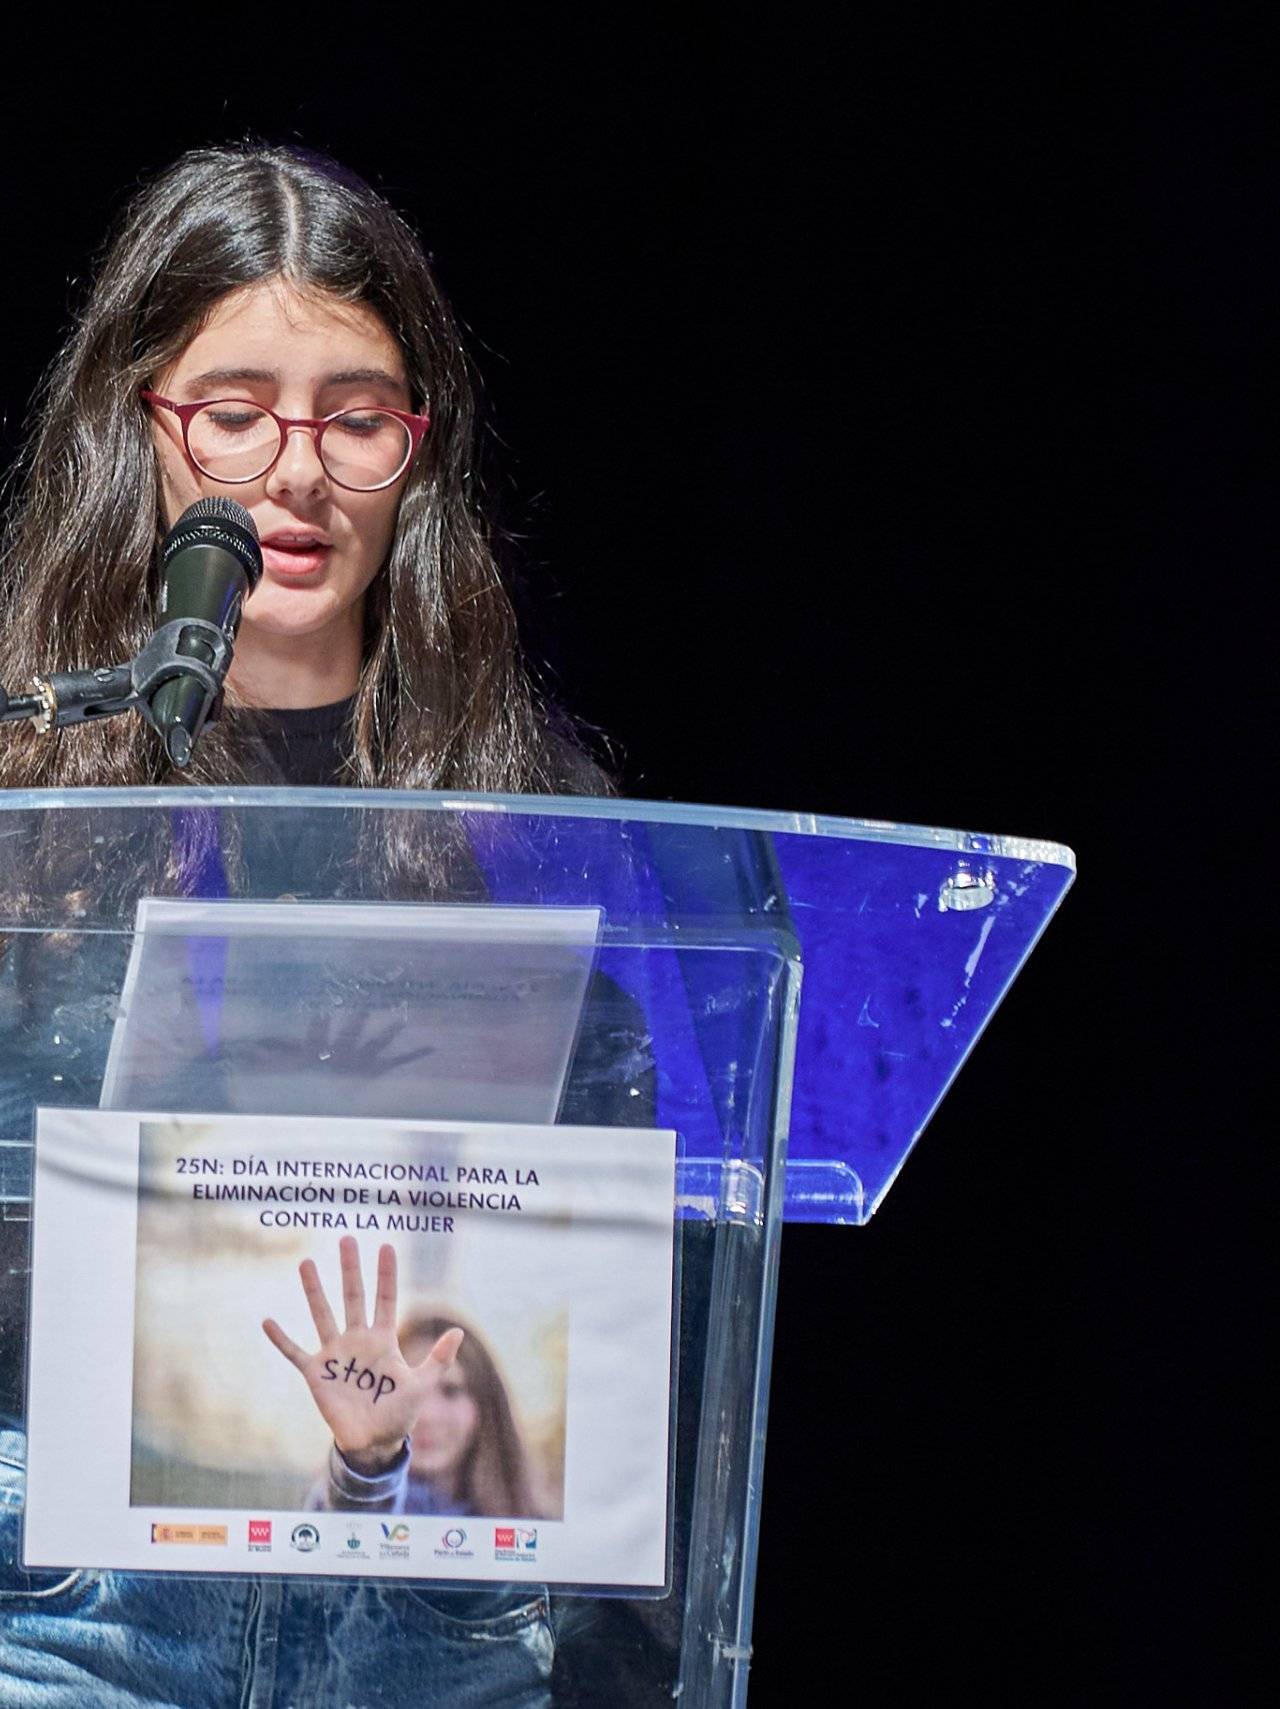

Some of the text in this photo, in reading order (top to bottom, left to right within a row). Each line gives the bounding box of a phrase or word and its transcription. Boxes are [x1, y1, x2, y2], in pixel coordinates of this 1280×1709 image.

[176, 1155, 539, 1186] 25N: DÍA INTERNACIONAL PARA LA
[193, 1182, 521, 1211] ELIMINACIÓN DE LA VIOLENCIA
[260, 1210, 454, 1233] CONTRA LA MUJER
[321, 1357, 396, 1404] stop
